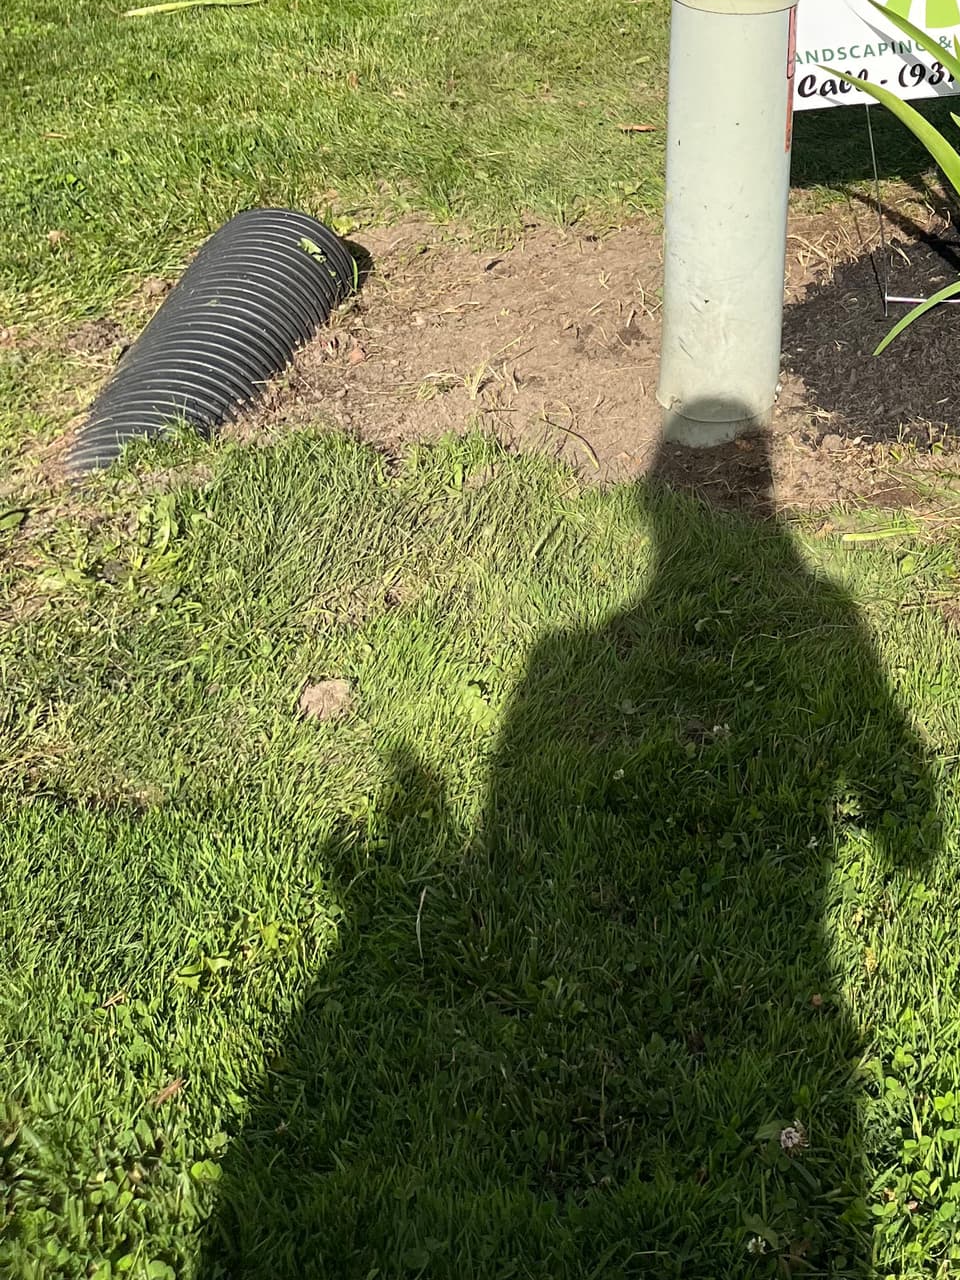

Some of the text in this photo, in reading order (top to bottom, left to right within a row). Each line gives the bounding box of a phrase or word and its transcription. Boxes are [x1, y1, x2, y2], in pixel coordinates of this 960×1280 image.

[793, 39, 927, 65] ANDSCAPIN
[938, 35, 952, 49] &
[798, 68, 869, 98] Call
